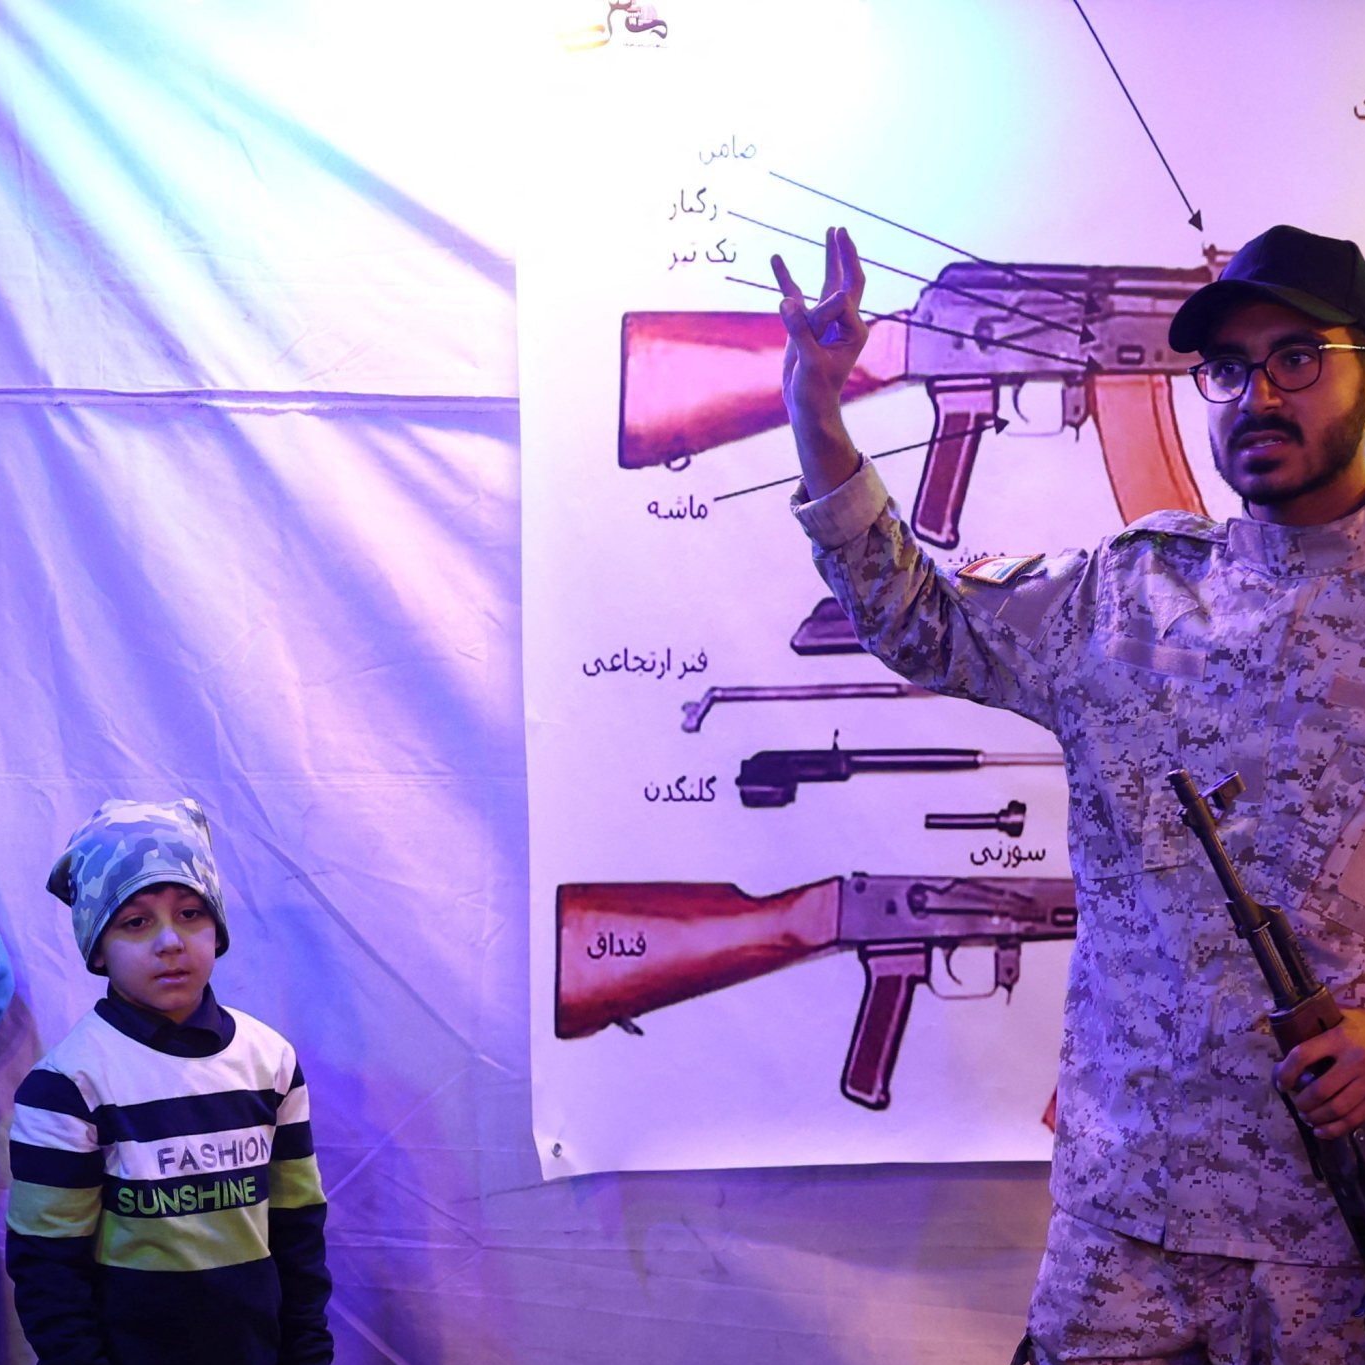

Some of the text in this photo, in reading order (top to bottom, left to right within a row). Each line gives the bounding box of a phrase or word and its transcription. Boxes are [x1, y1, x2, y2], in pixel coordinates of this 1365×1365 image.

[647, 494, 709, 520] ماشه
[583, 647, 708, 680] فنر ارتجاعی
[644, 775, 717, 802] گلنگدن
[970, 840, 1046, 868] سوزنی
[587, 931, 647, 960] قنداق
[117, 1176, 257, 1216] SUNSHINE
